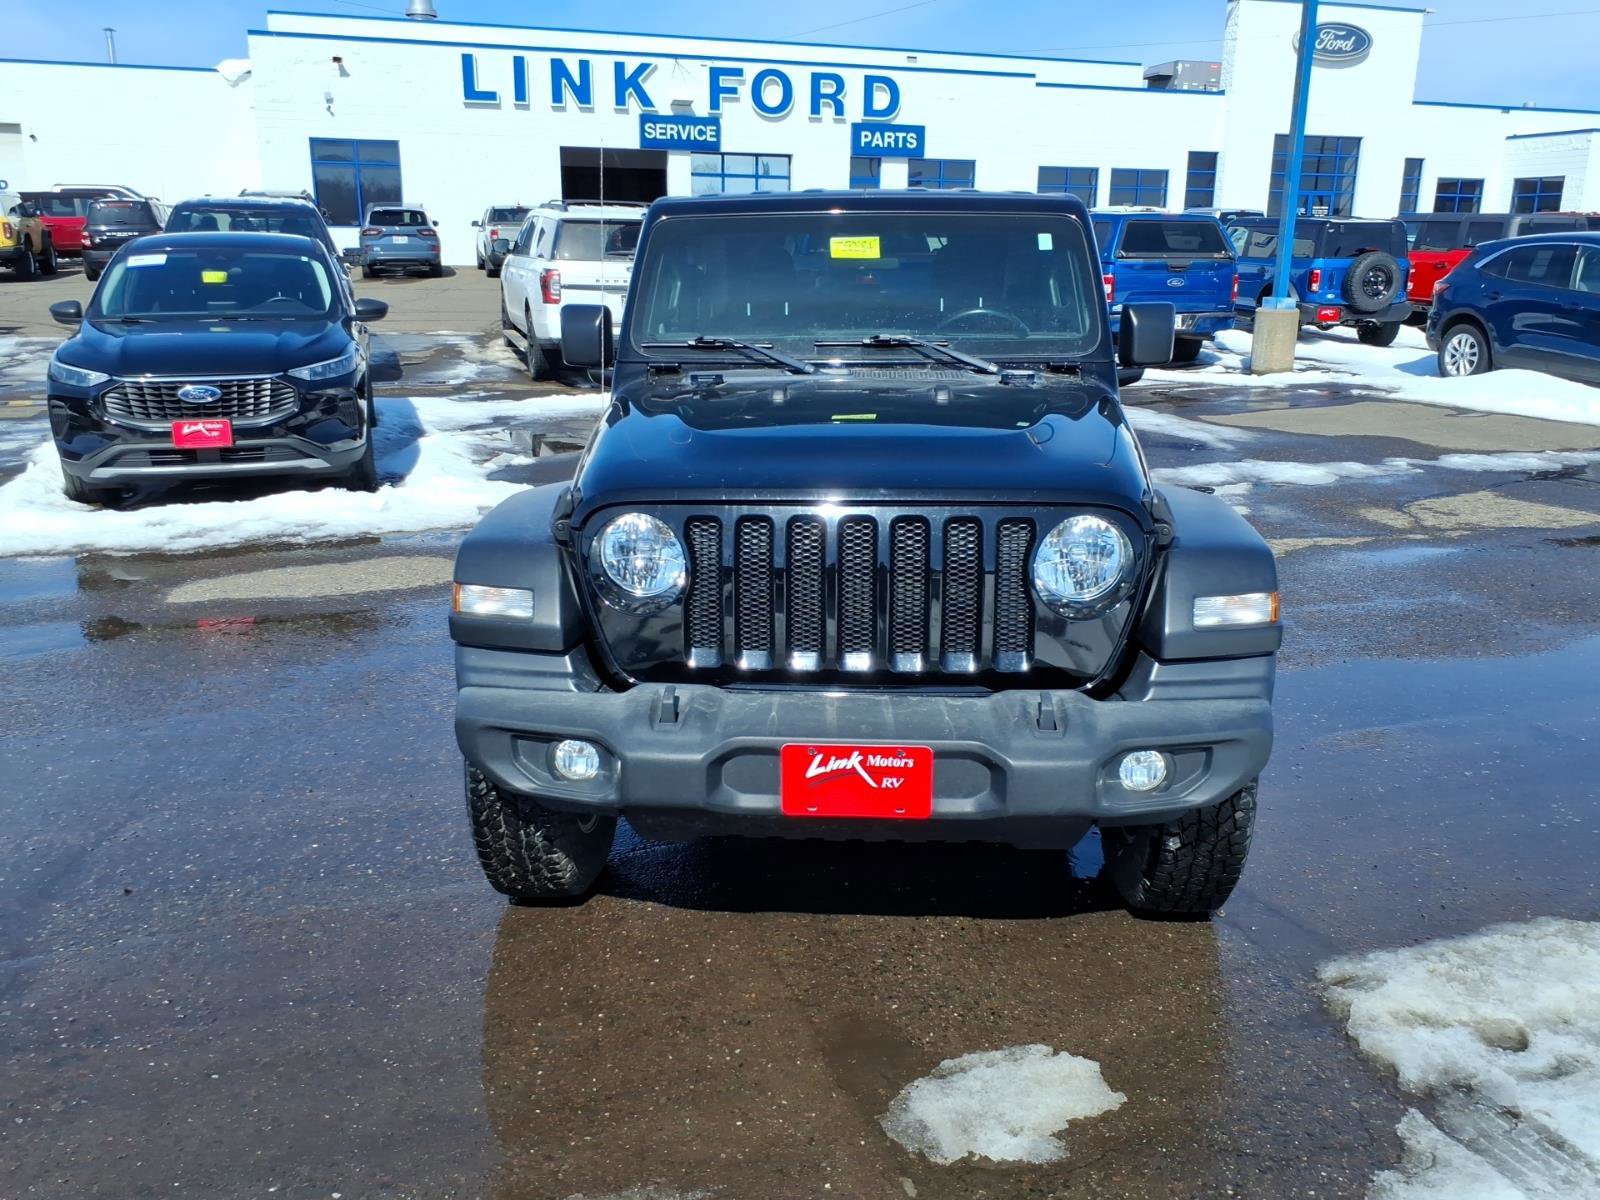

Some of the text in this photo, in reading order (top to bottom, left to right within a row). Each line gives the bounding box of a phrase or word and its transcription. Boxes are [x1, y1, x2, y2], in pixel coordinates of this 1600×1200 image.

[1315, 29, 1355, 51] Ford
[461, 53, 901, 119] LINK FORD
[644, 123, 717, 142] SERVICE
[860, 131, 918, 149] PARTS
[805, 751, 914, 788] Link Motors
[881, 778, 904, 788] RV
